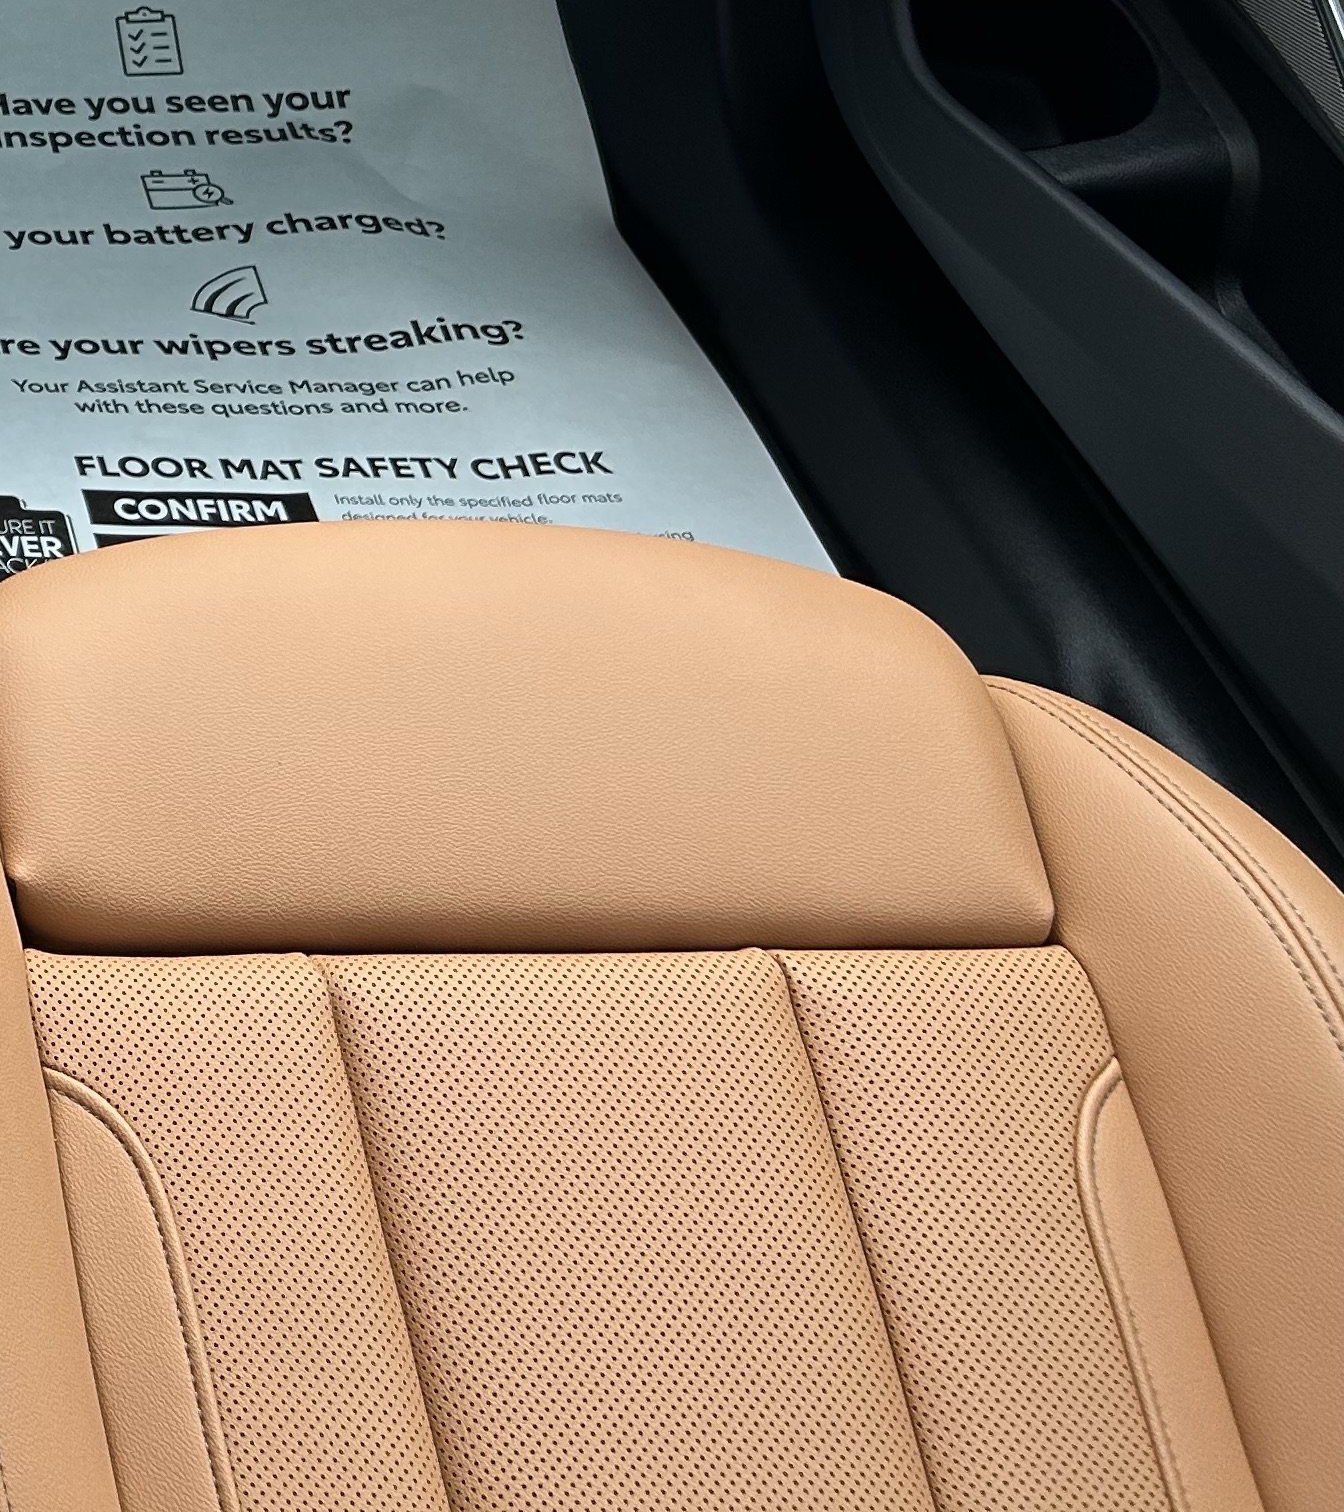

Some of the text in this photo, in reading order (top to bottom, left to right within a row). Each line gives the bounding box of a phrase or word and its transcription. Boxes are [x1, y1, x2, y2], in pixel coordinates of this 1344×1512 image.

[83, 95, 156, 121] you
[165, 91, 255, 114] seen
[262, 89, 352, 118] your
[204, 120, 354, 147] results?
[7, 225, 95, 250] your
[103, 220, 254, 246] battery
[265, 212, 446, 240] charged?
[53, 335, 145, 360] your
[154, 334, 296, 360] wipers
[305, 316, 526, 357] streaking?
[12, 366, 515, 397] Your Assistant Service Manager can help
[73, 398, 469, 417] with these questions and more.
[73, 451, 614, 481] FLOOR MAT SAFETY CHECK
[113, 496, 288, 523] CONFIRM
[334, 491, 623, 510] Install only the specified floor mats
[39, 519, 56, 535] IT
